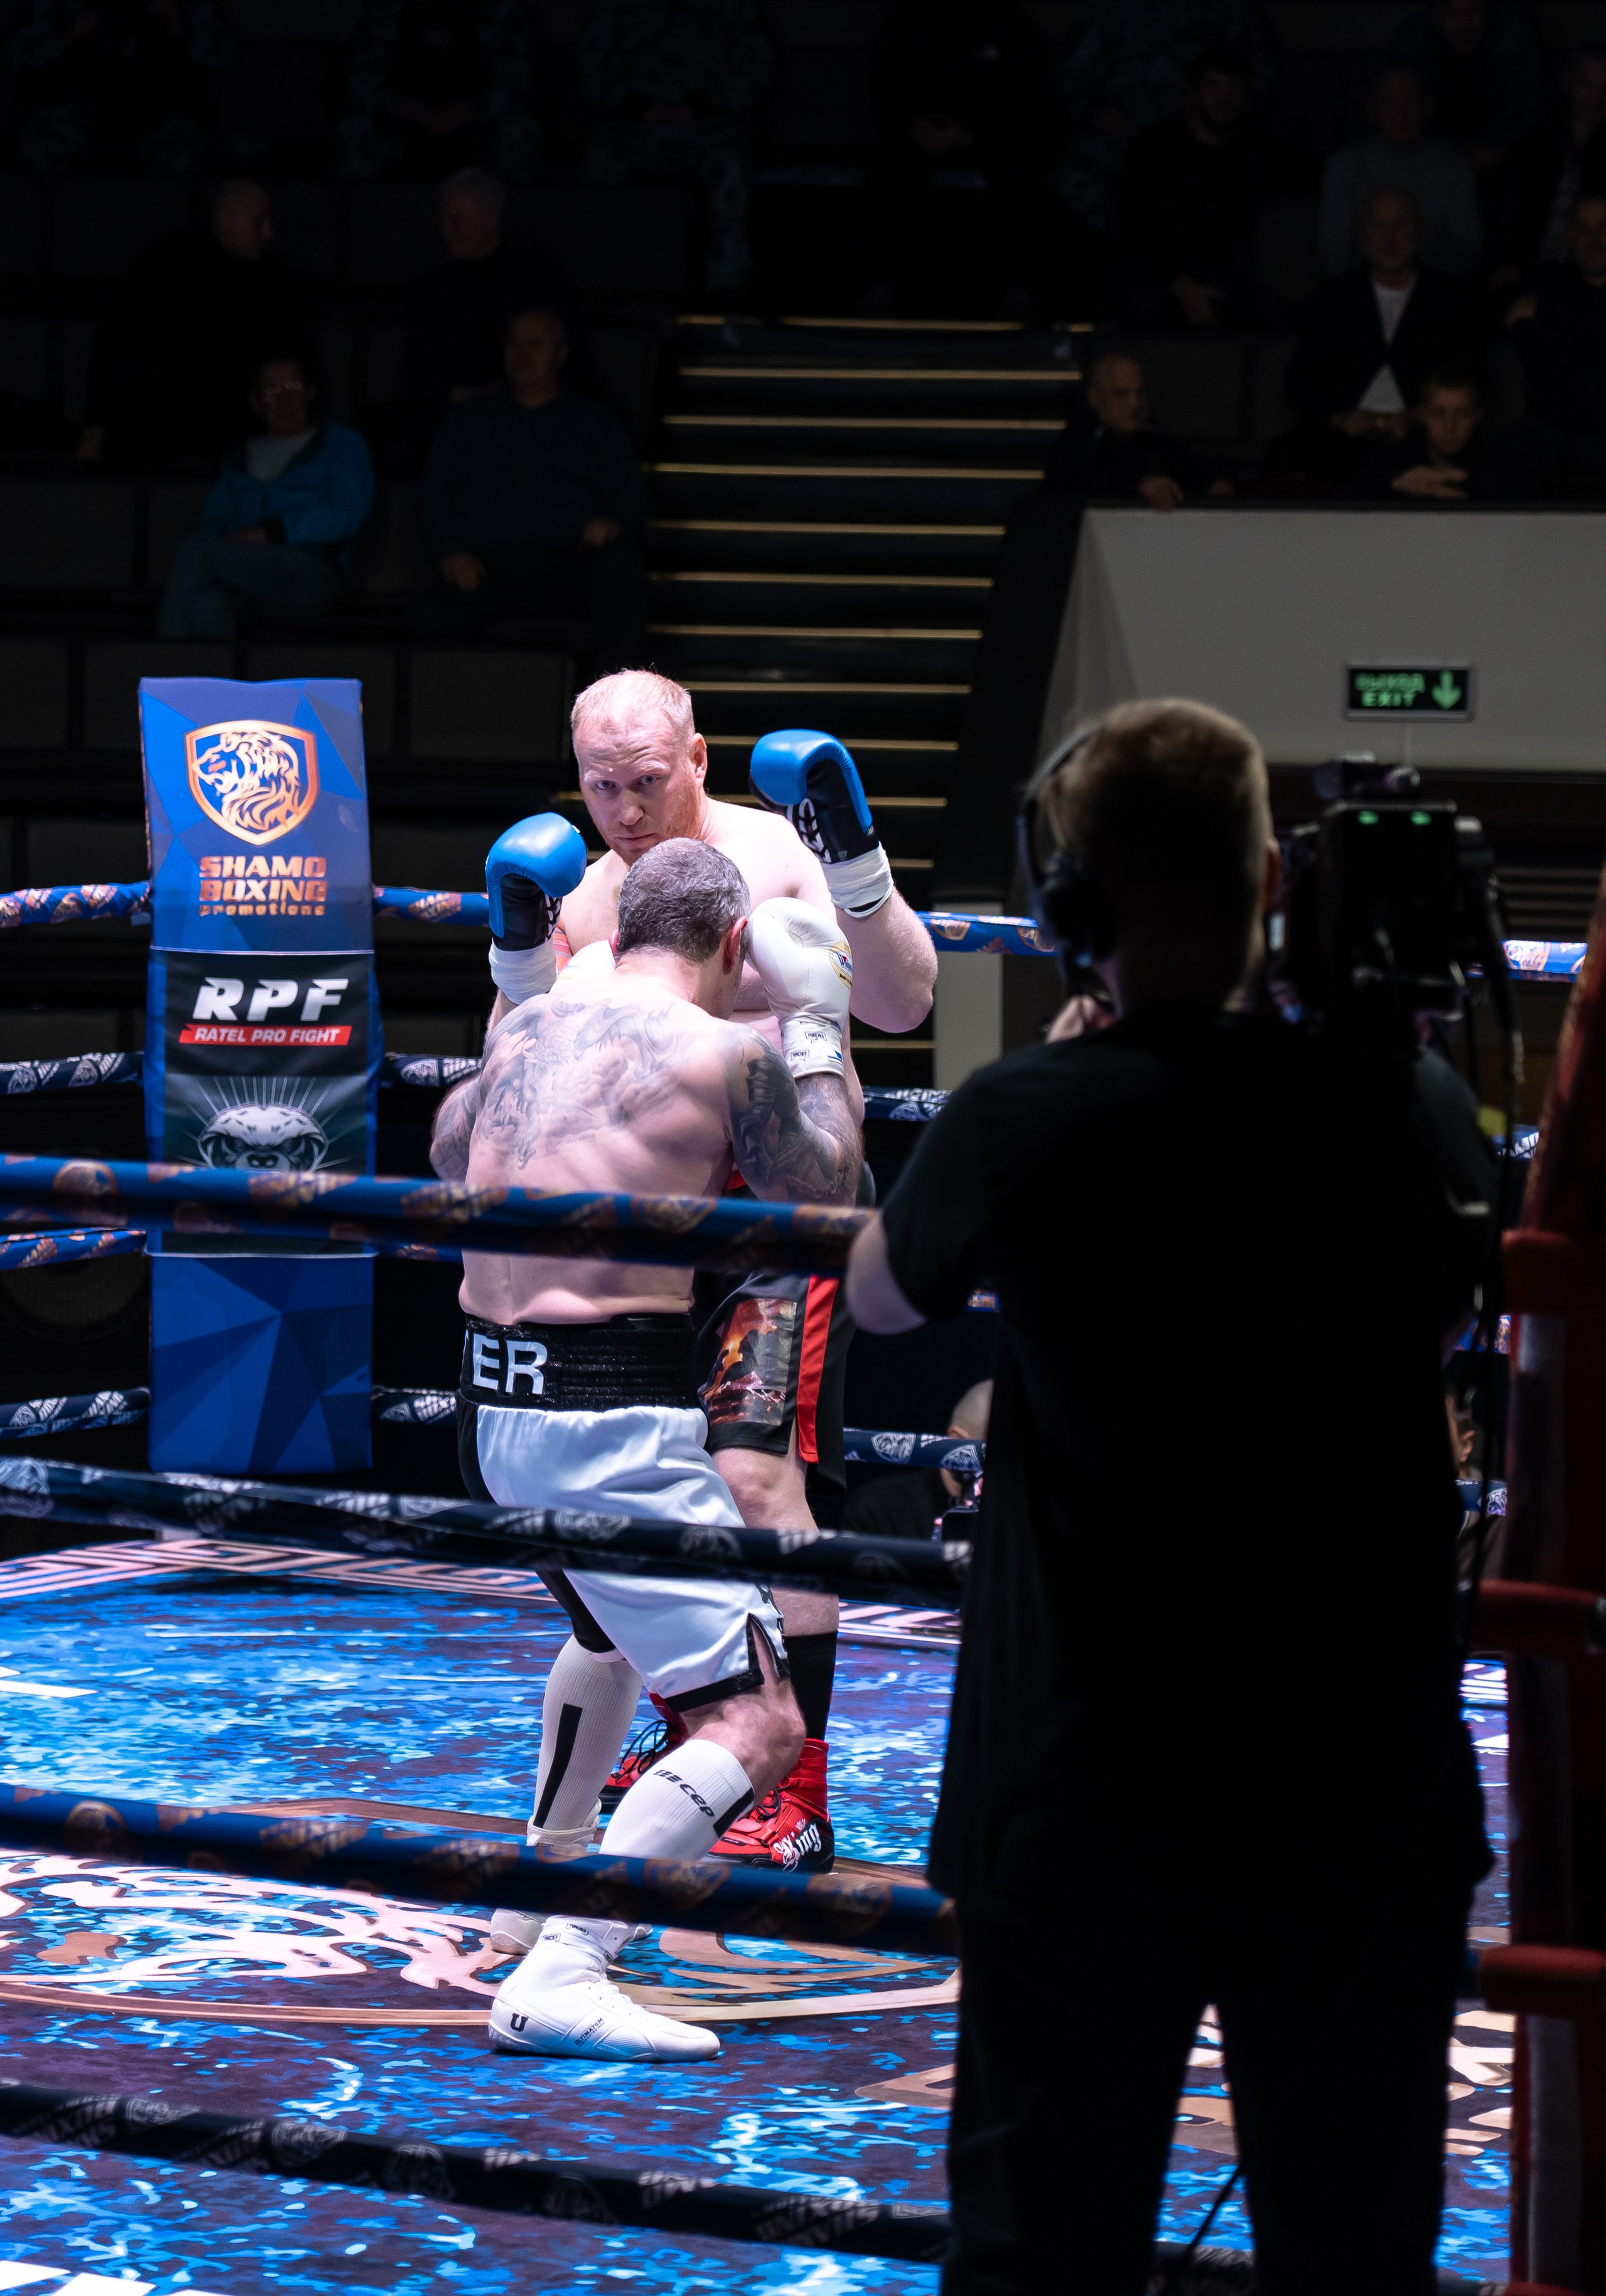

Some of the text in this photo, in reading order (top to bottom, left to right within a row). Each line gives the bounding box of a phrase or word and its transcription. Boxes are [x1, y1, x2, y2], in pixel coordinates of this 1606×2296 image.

[1361, 691, 1415, 707] EXIT
[199, 855, 326, 878] SHAMO
[199, 879, 327, 902] BOXING
[192, 976, 349, 1021] RPF
[194, 1027, 341, 1043] RATEL PRO FIGHT
[460, 1329, 548, 1395] ER
[509, 2013, 529, 2033] U
[574, 2017, 604, 2045] ULTIMATUM
